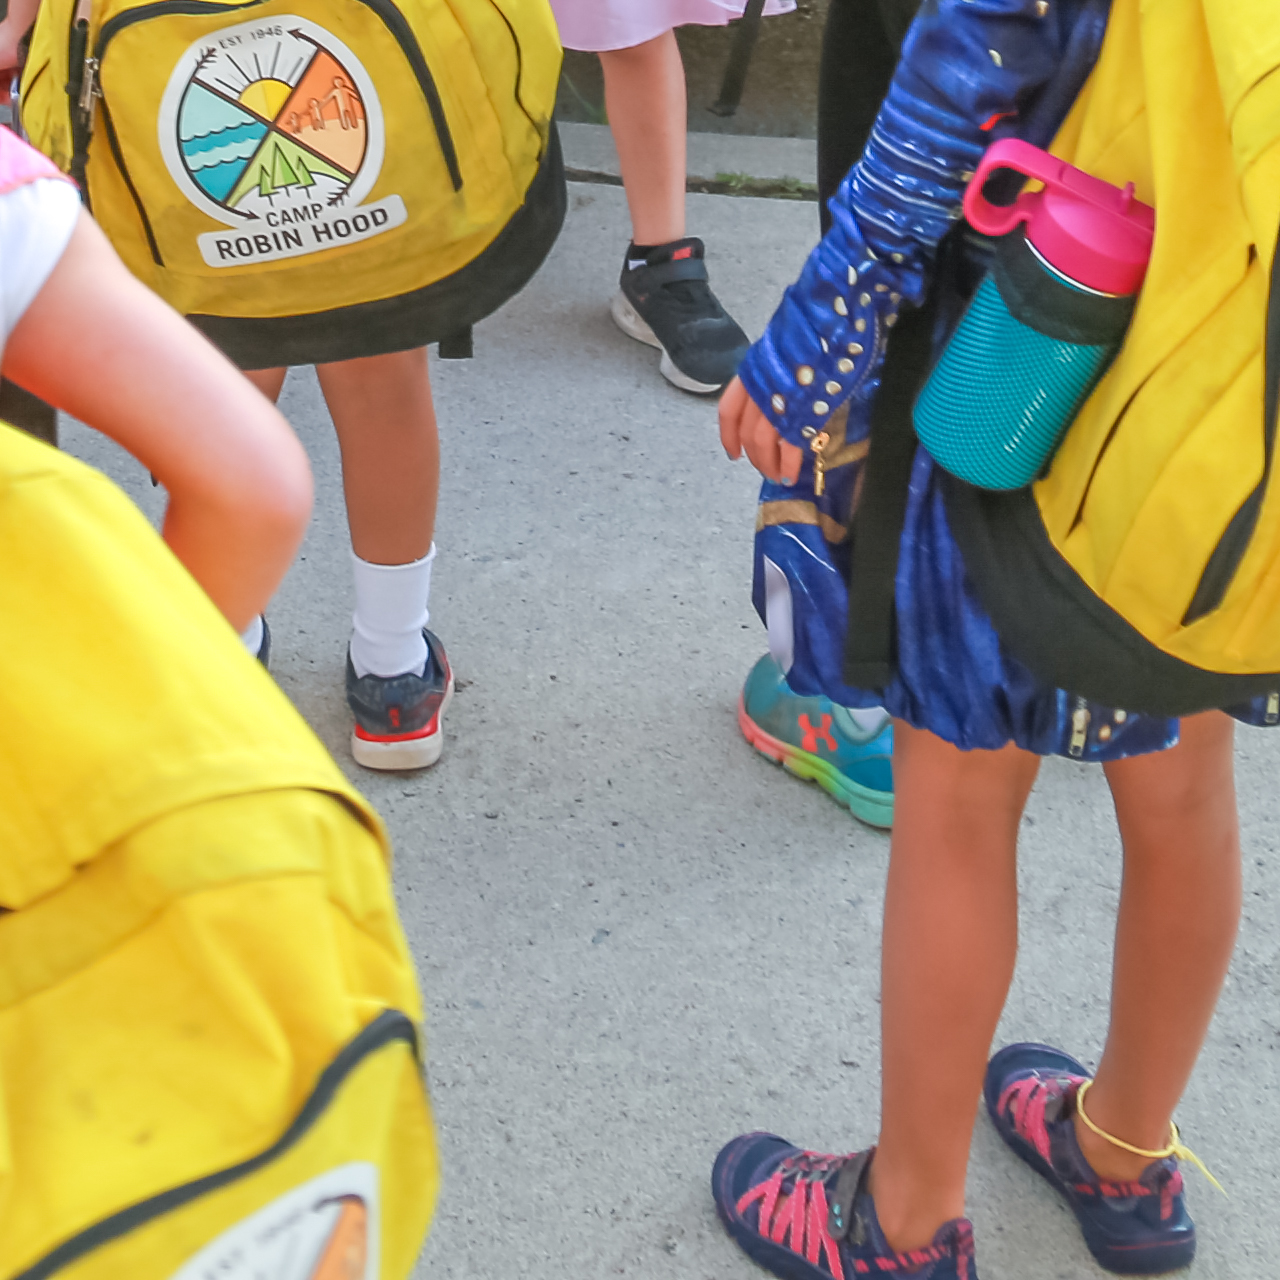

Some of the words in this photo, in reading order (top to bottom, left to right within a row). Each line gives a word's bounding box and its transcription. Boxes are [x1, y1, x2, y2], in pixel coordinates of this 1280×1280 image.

[219, 35, 243, 51] EST
[265, 203, 324, 229] CAMP
[215, 227, 304, 261] ROBIN
[311, 207, 389, 244] HOOD
